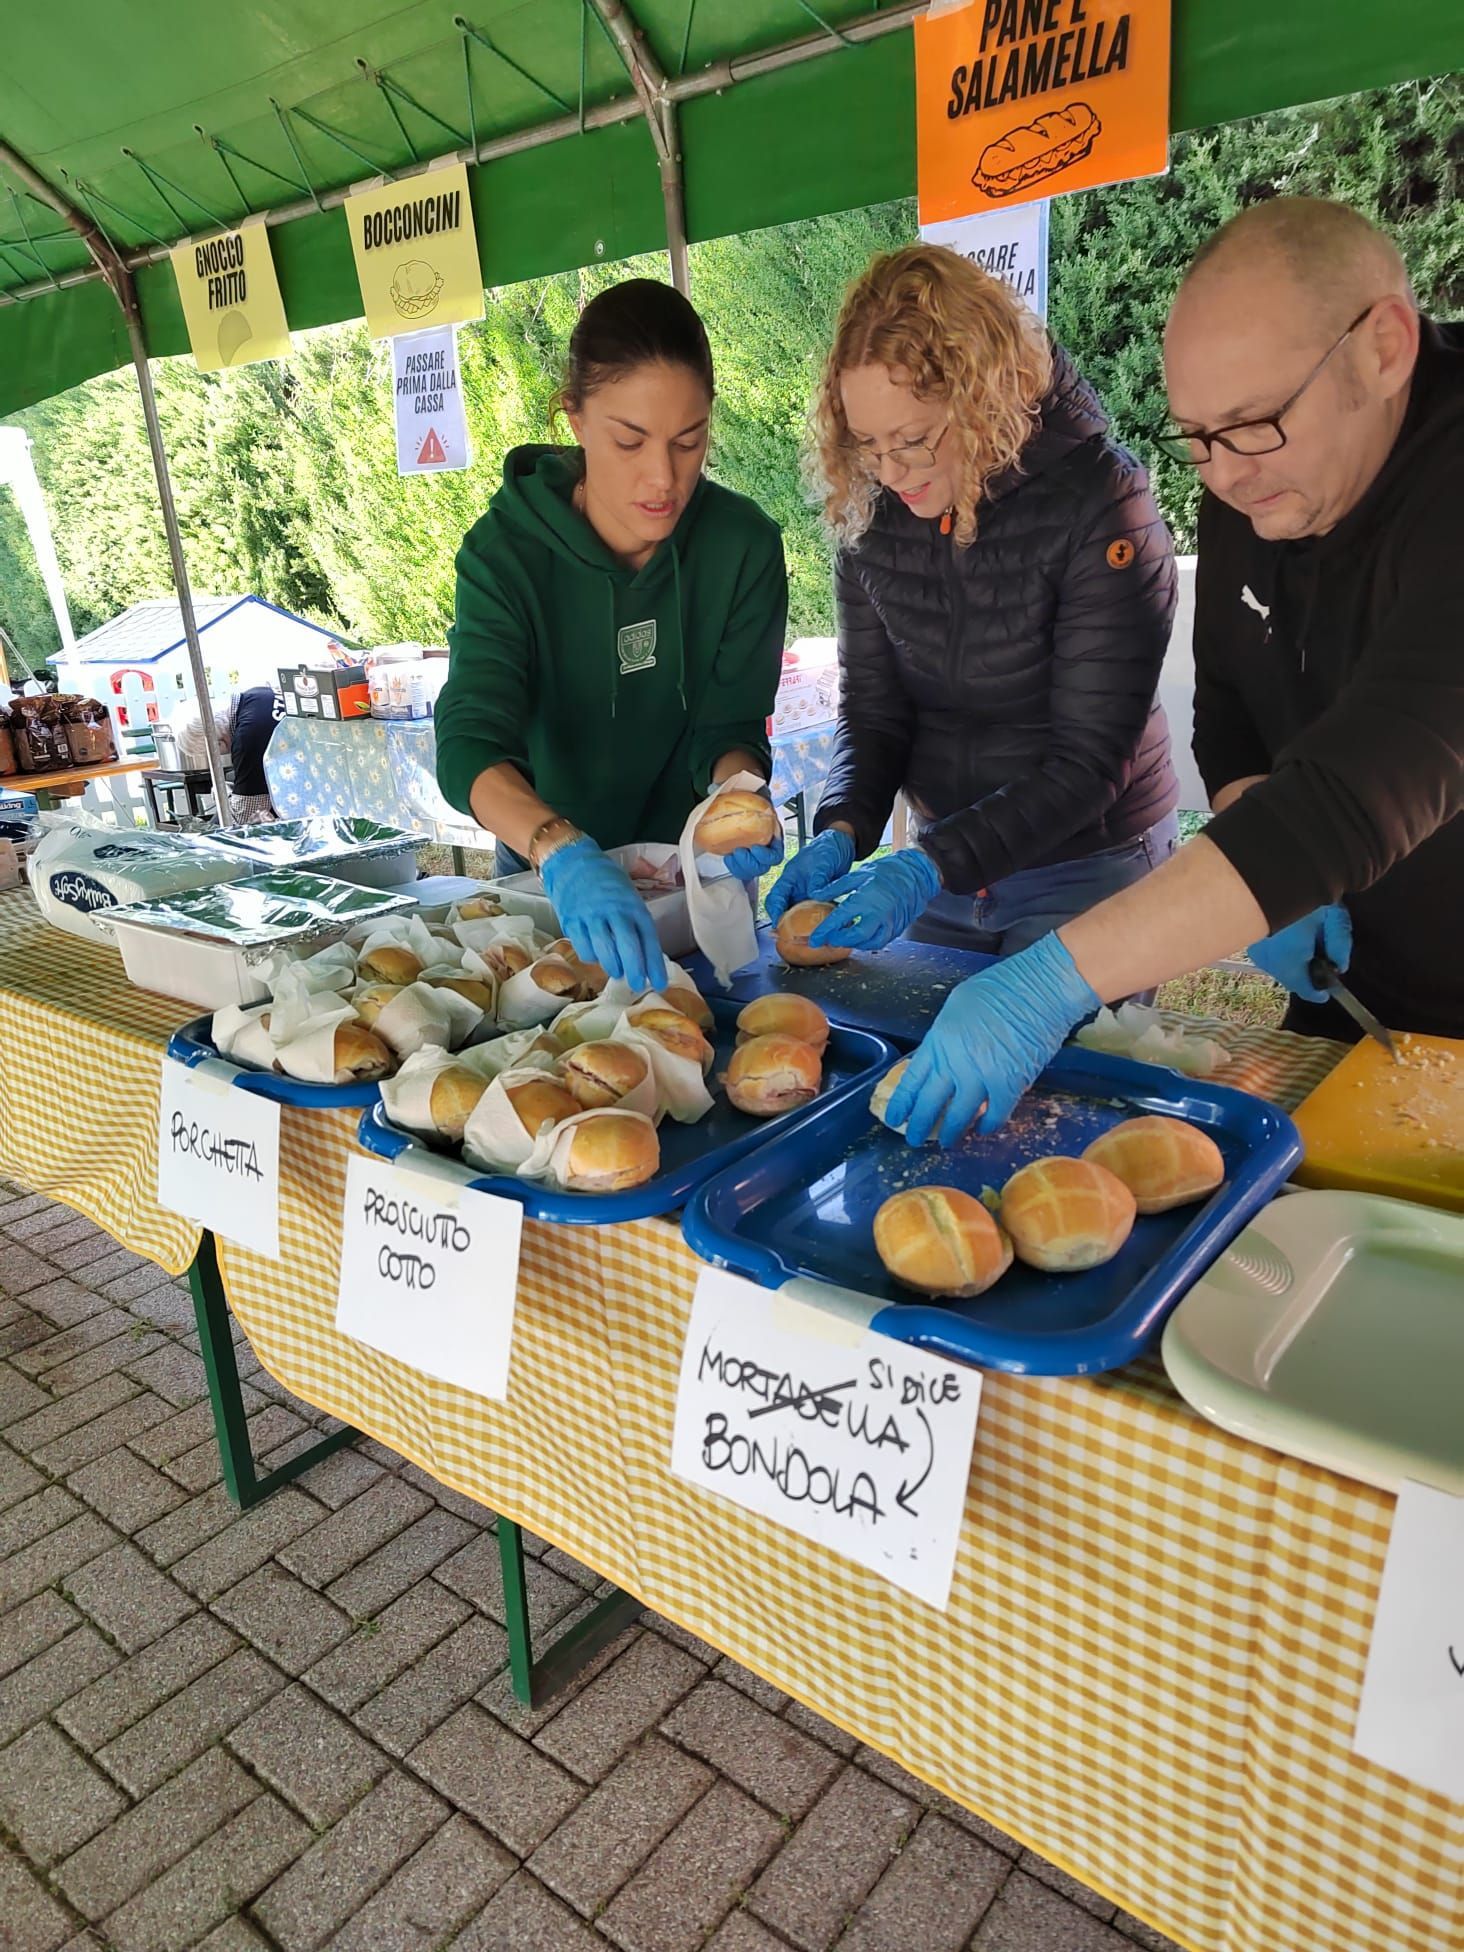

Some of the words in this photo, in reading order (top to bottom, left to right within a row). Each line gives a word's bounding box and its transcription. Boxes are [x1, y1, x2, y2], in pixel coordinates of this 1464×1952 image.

[979, 0, 1062, 53] PANE
[946, 14, 1130, 120] SALAMELLA
[363, 190, 460, 251] BOCCONCINI
[195, 234, 244, 278] GNOCCO
[207, 269, 247, 310] FRITTO
[396, 374, 427, 396] PRIMA
[429, 369, 456, 392] DALLA
[405, 350, 445, 375] PASSARE
[414, 392, 444, 414] CASSA
[54, 875, 112, 909] BulkySoft
[171, 1111, 264, 1182] PORCHETTA
[364, 1188, 471, 1253] PROSCIUTTO
[378, 1245, 436, 1290] COTTO
[868, 1358, 895, 1389] SI
[702, 1412, 886, 1525] BONDOLA
